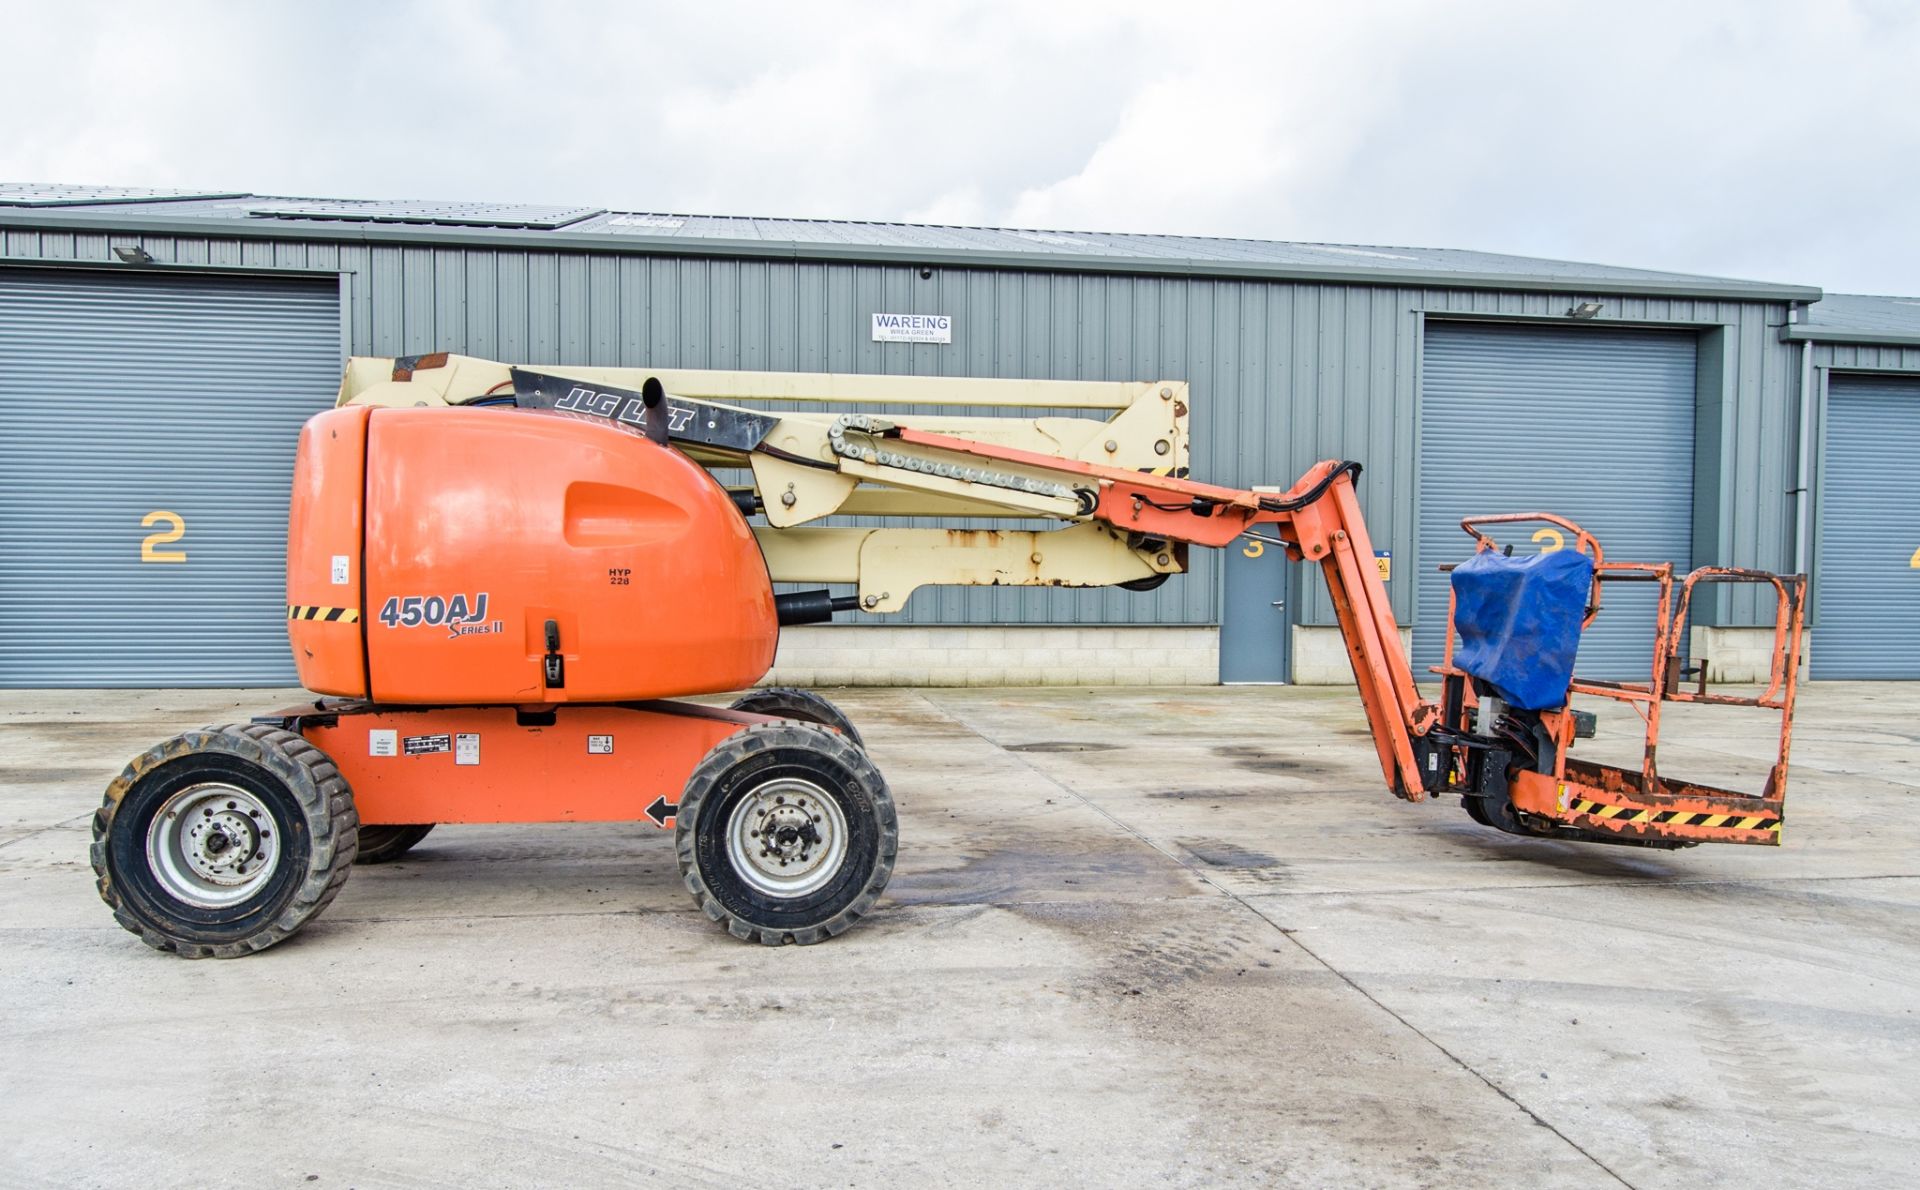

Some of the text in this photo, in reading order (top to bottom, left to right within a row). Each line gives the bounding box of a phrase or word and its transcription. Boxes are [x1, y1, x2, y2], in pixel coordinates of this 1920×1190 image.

[877, 315, 948, 329] WAREING
[554, 388, 622, 416] JLG
[141, 510, 187, 562] 2
[609, 569, 631, 577] HYP
[379, 593, 488, 628] 450AJ
